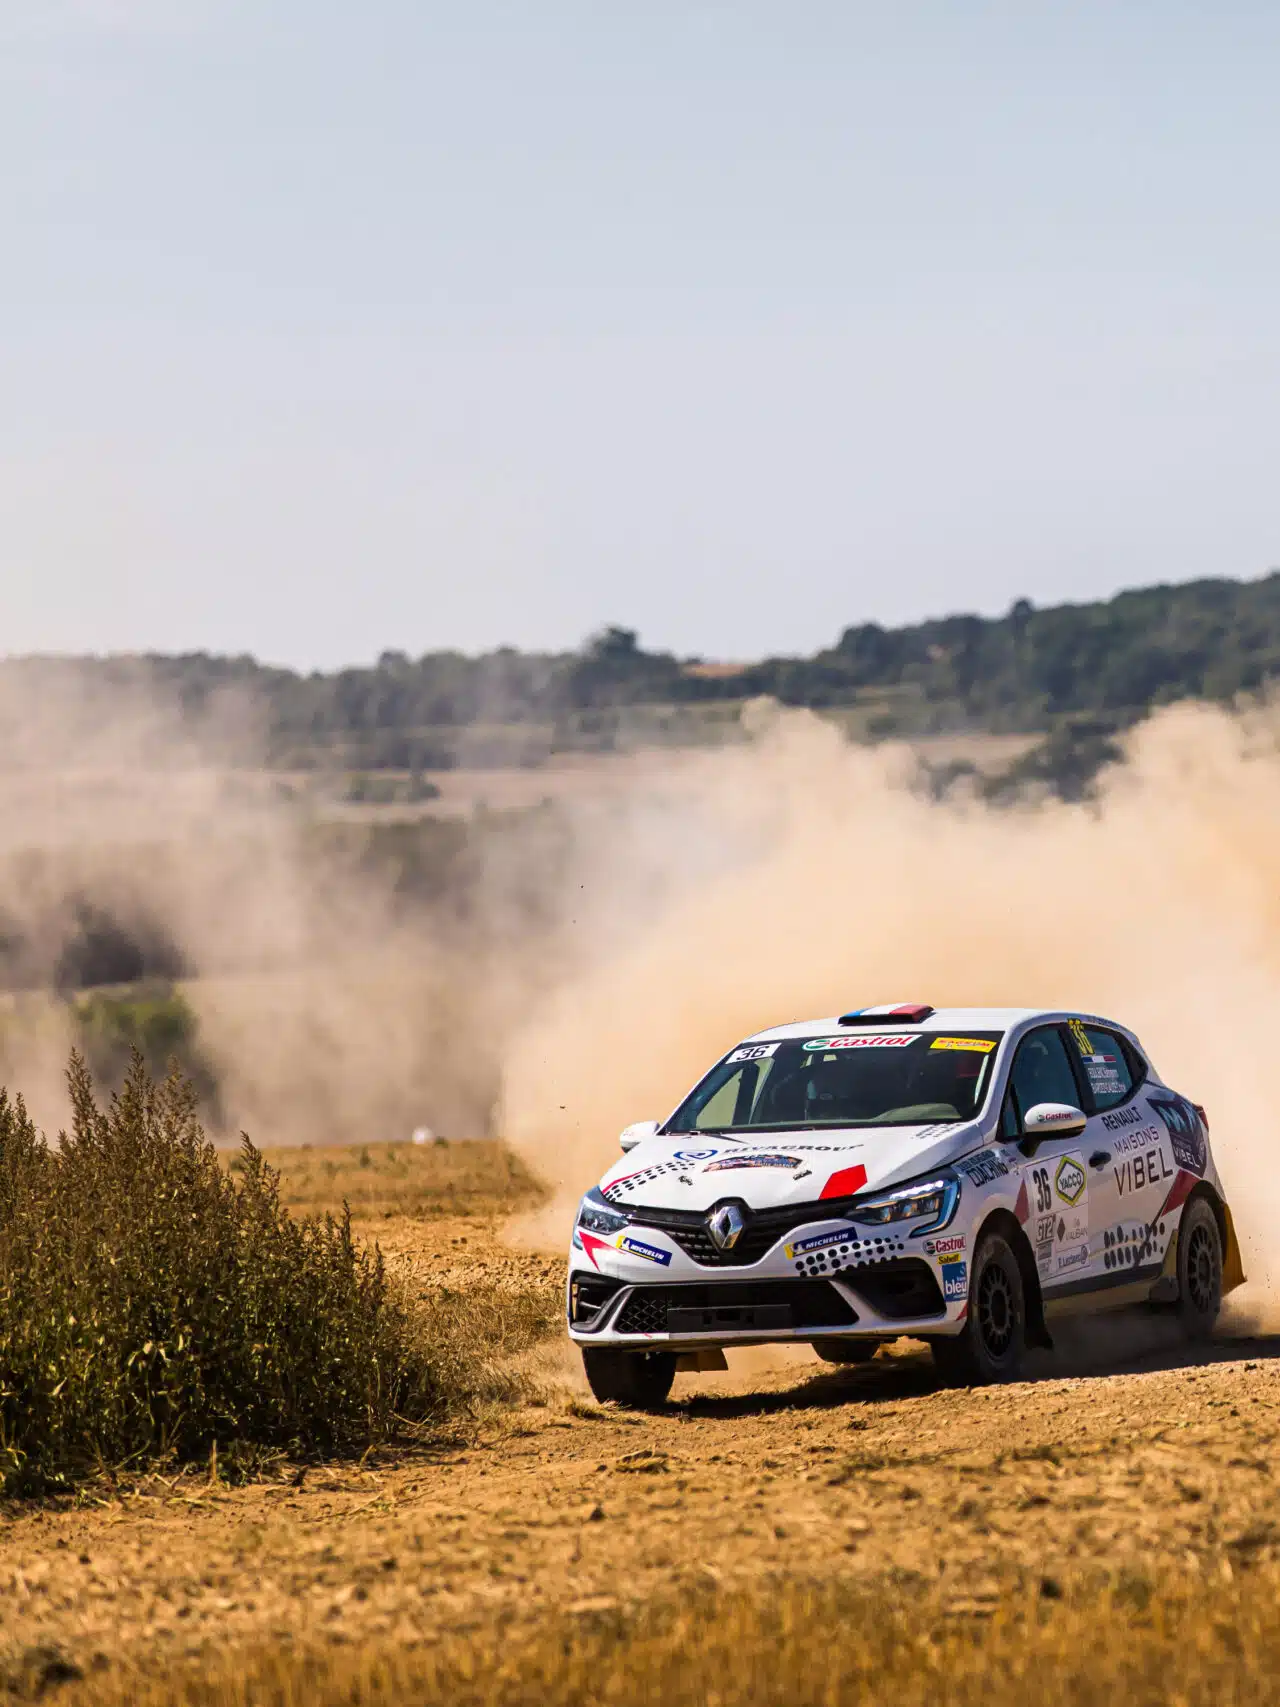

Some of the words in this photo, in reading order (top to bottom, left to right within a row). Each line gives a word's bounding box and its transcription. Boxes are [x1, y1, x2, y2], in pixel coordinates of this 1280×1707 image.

[829, 1035, 914, 1048] Castrol
[735, 1045, 771, 1061] 36
[1101, 1106, 1143, 1132] RENAULT
[1113, 1126, 1160, 1154] MAISONS
[1113, 1147, 1174, 1196] VIBEL
[1059, 1172, 1082, 1190] YACCO
[1033, 1168, 1052, 1212] 36
[805, 1232, 850, 1249] MICHELIN
[936, 1236, 966, 1253] Castrol
[629, 1243, 665, 1260] MICHELIN
[945, 1279, 967, 1295] bleu
